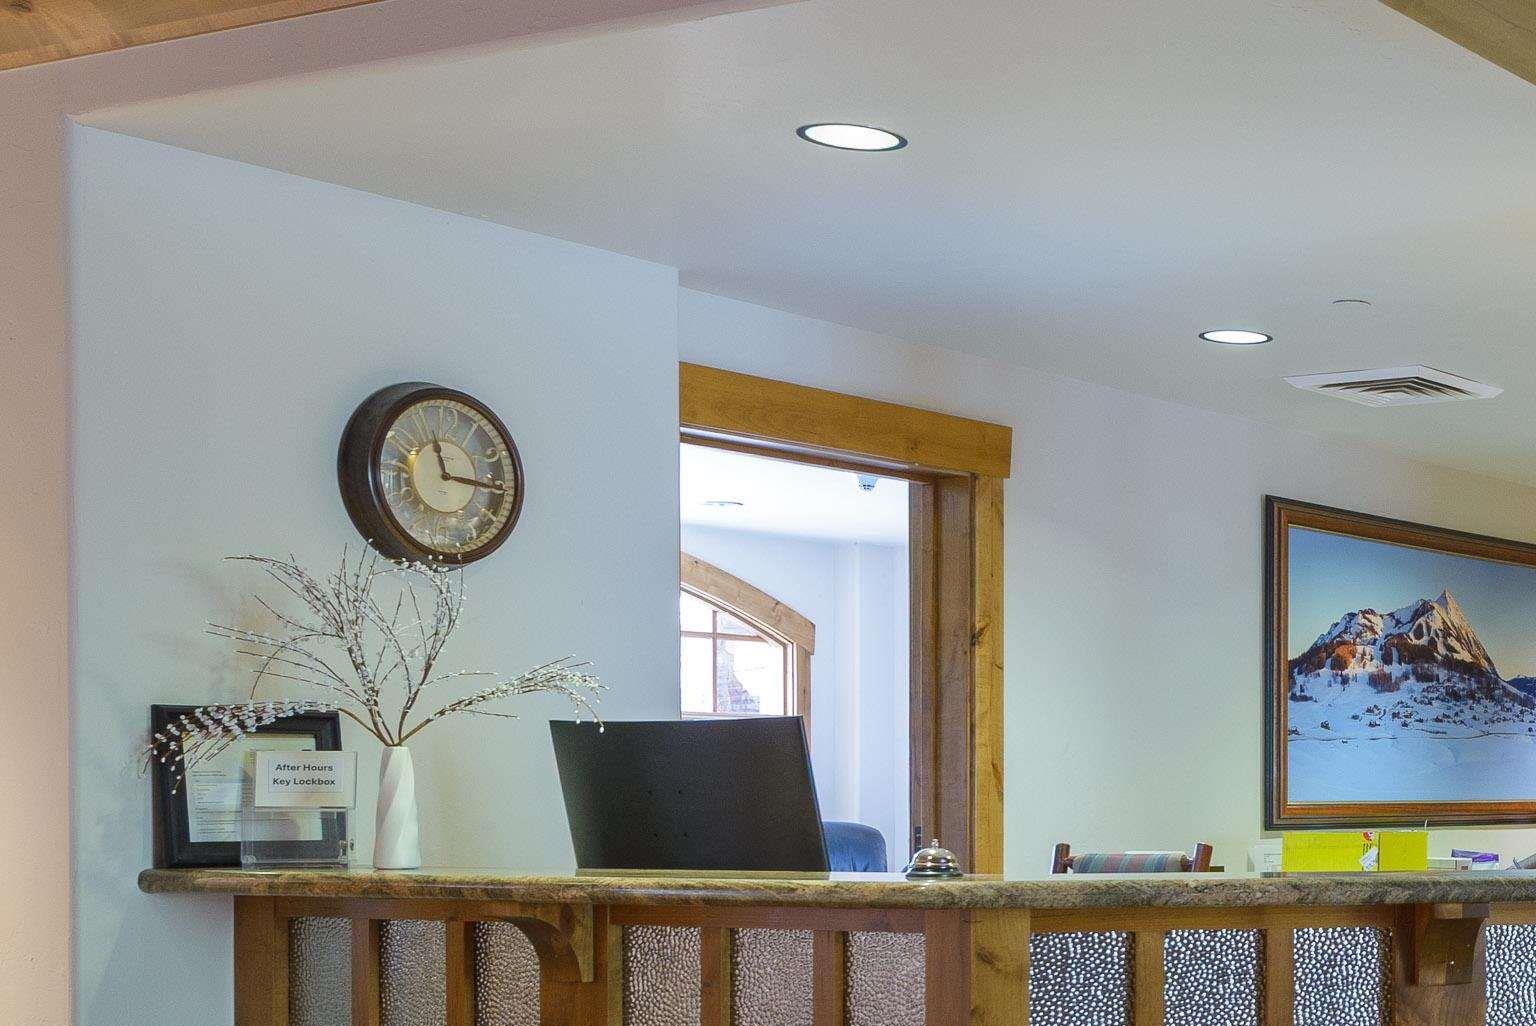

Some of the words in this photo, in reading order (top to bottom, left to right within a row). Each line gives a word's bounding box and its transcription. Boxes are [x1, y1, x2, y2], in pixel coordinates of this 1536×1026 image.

[275, 763, 302, 772] After
[303, 763, 334, 772] Hours
[272, 777, 291, 787] Key
[293, 777, 336, 786] Lockbox
